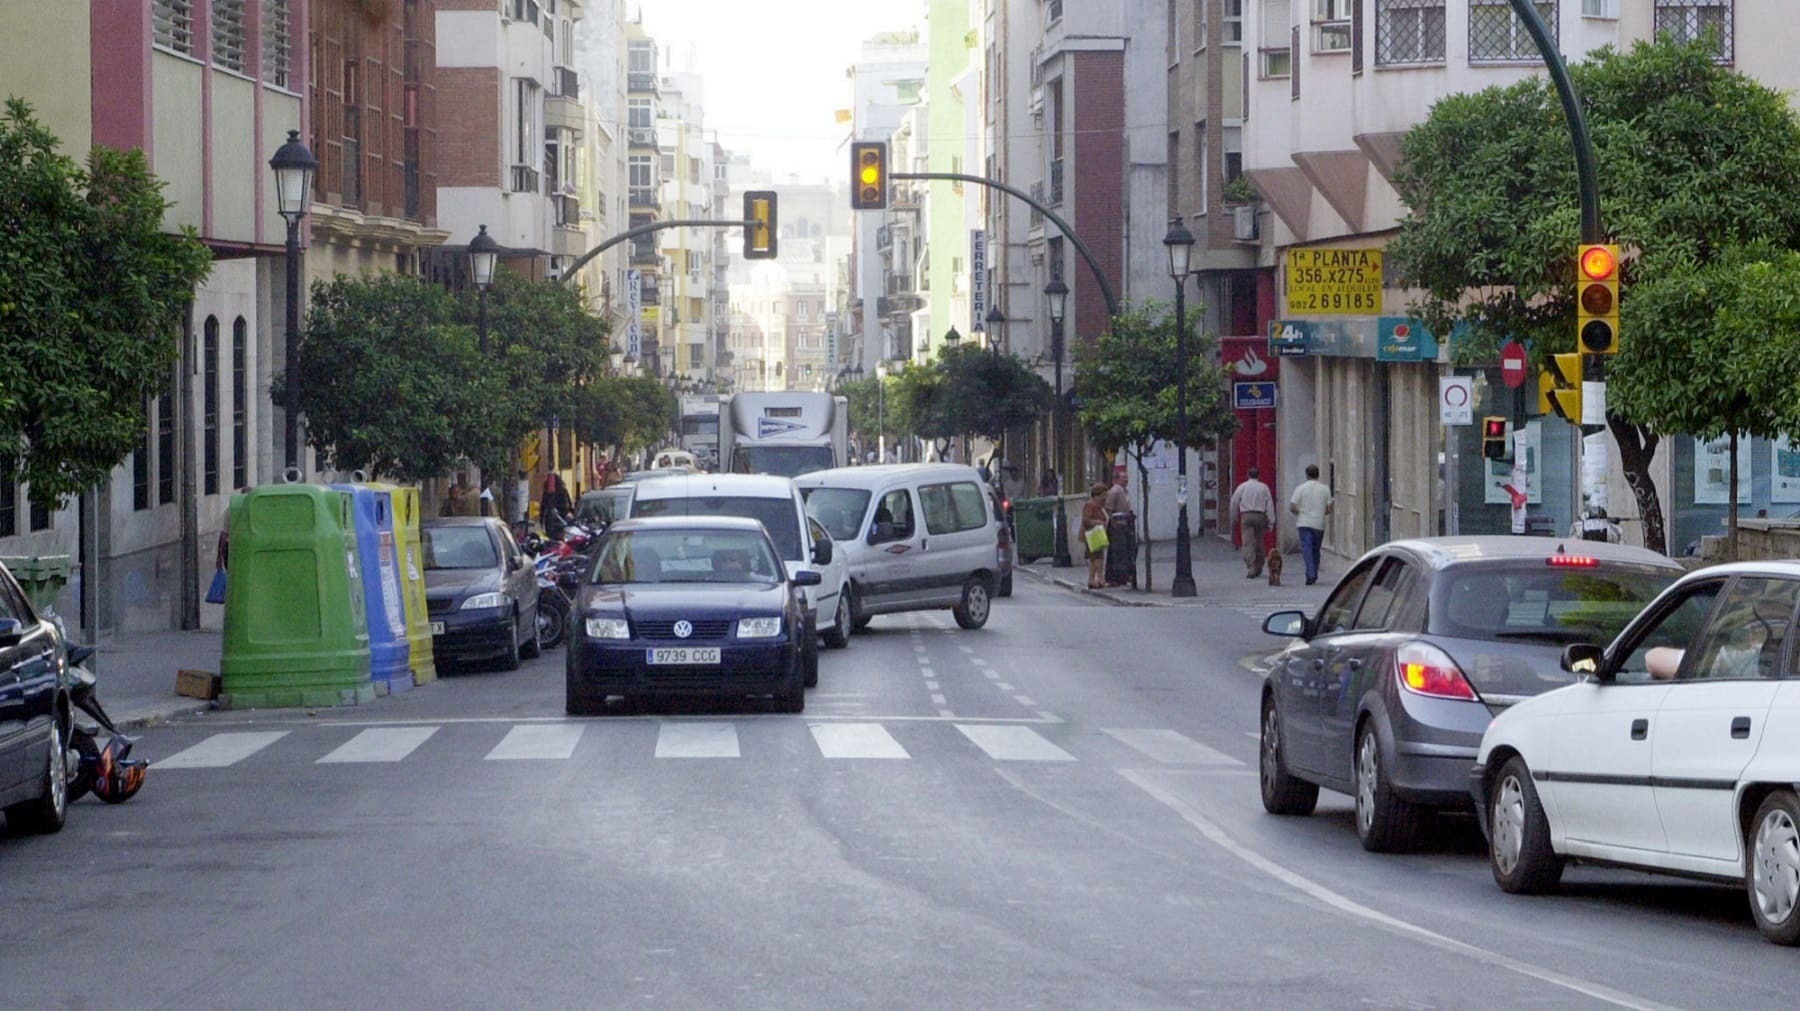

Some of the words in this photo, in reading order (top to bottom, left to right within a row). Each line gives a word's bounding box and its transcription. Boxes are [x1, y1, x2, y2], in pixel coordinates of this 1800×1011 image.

[1313, 250, 1369, 266] PLANTA
[656, 650, 687, 662] 9739
[692, 650, 717, 662] CCG
